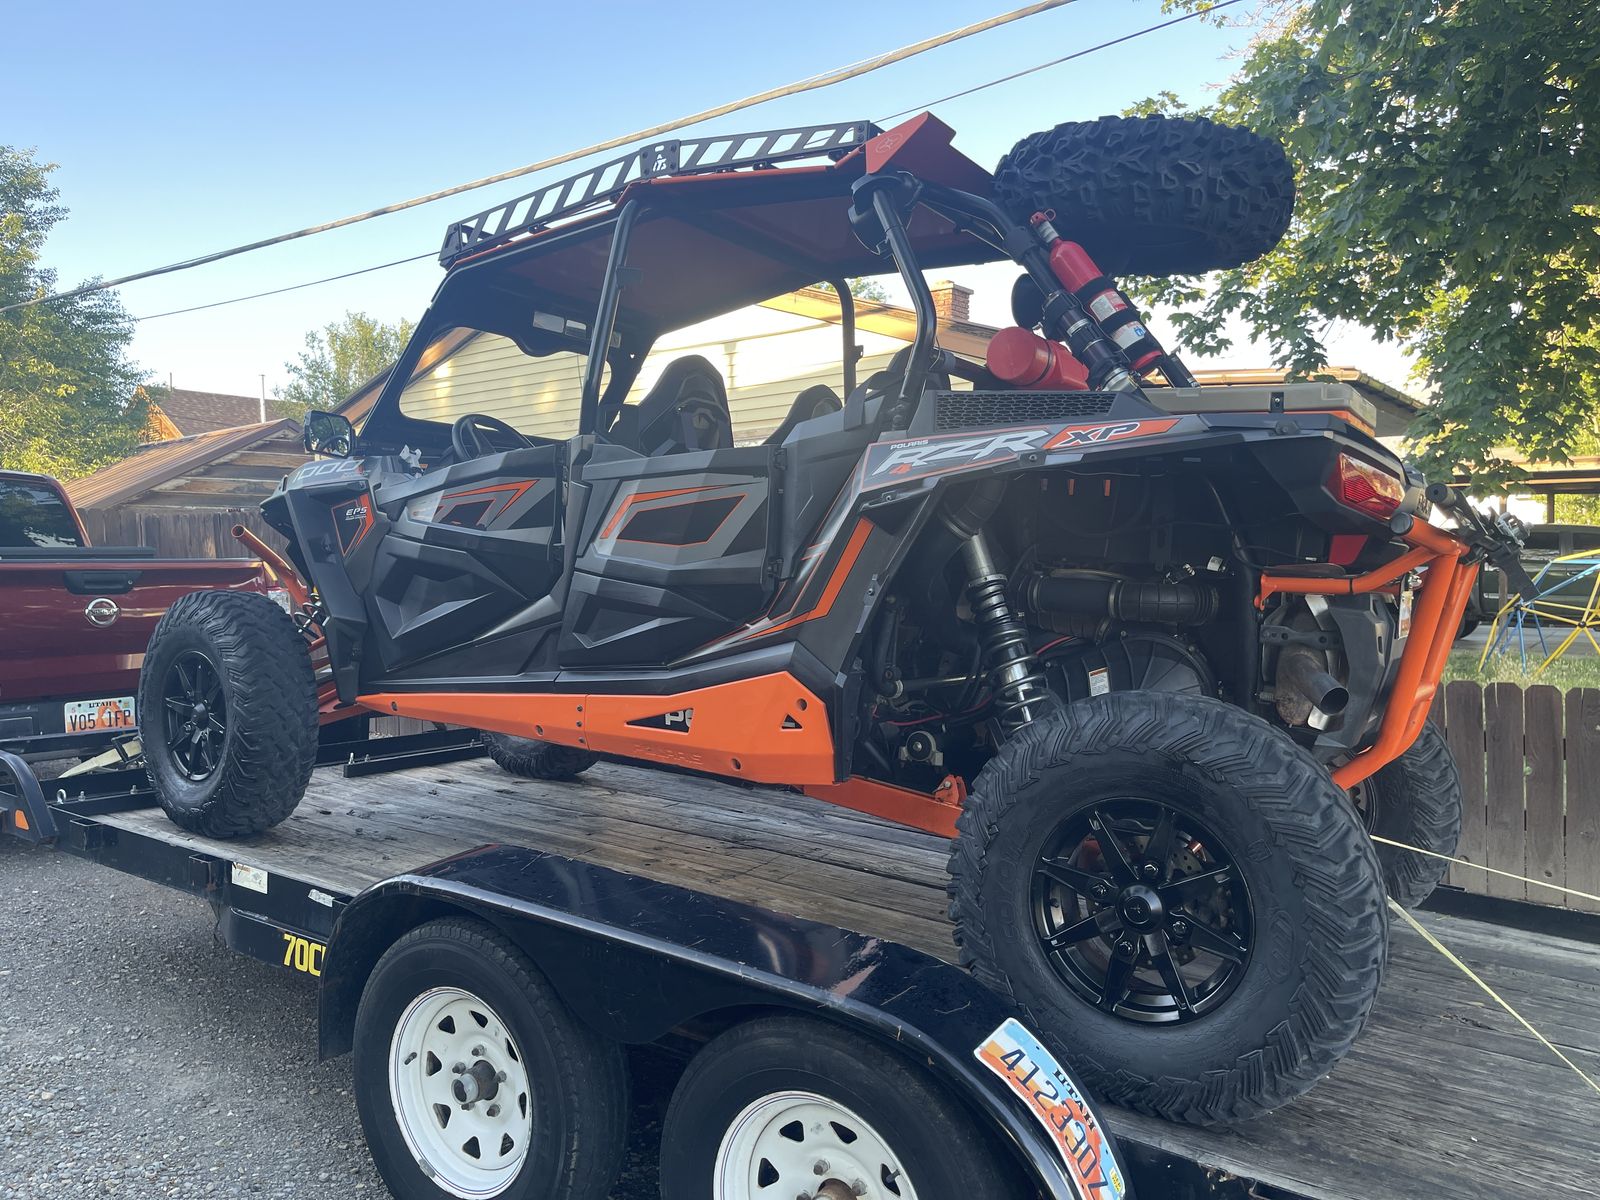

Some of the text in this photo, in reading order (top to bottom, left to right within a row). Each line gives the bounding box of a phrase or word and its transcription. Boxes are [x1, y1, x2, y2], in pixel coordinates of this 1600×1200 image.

[871, 422, 1140, 476] RZR XP
[890, 439, 929, 450] POLARIS
[345, 506, 368, 516] EPS
[88, 701, 112, 709] UTAH
[69, 709, 131, 732] V05 1FP
[1052, 1067, 1096, 1132] UTAH
